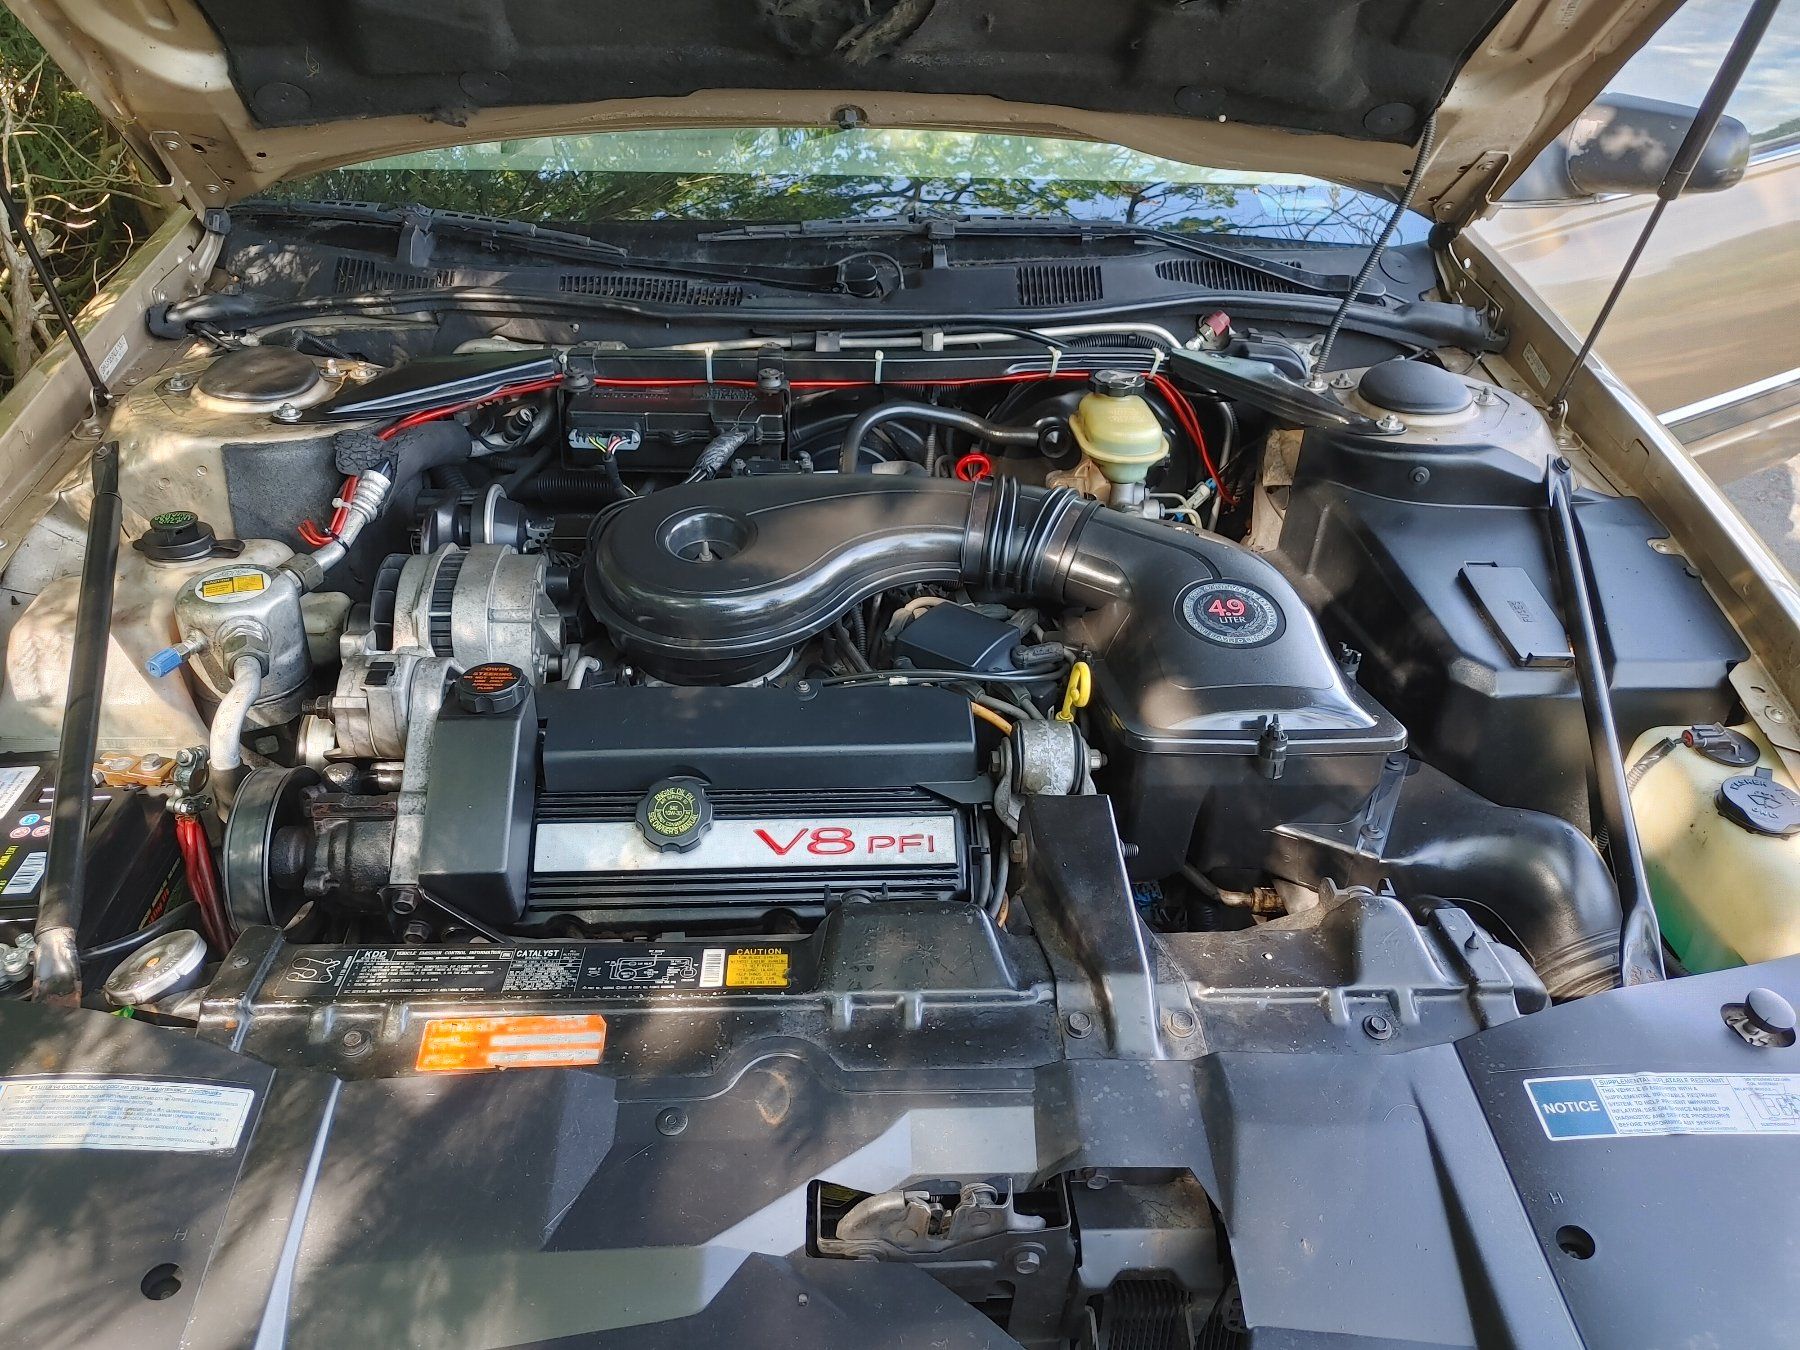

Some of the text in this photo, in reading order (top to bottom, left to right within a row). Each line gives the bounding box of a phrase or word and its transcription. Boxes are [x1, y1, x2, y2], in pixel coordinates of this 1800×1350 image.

[1208, 598, 1246, 617] 4.9
[1219, 616, 1247, 624] LITER
[654, 787, 696, 802] ENGINE OIL FILL
[648, 812, 699, 834] SEE OWNER'S MANUAL
[753, 826, 935, 856] V8 PFI
[1599, 1077, 1650, 1085] SUPPLEMENTAL
[1543, 1100, 1601, 1114] NOTICE
[1549, 1191, 1564, 1204] H
